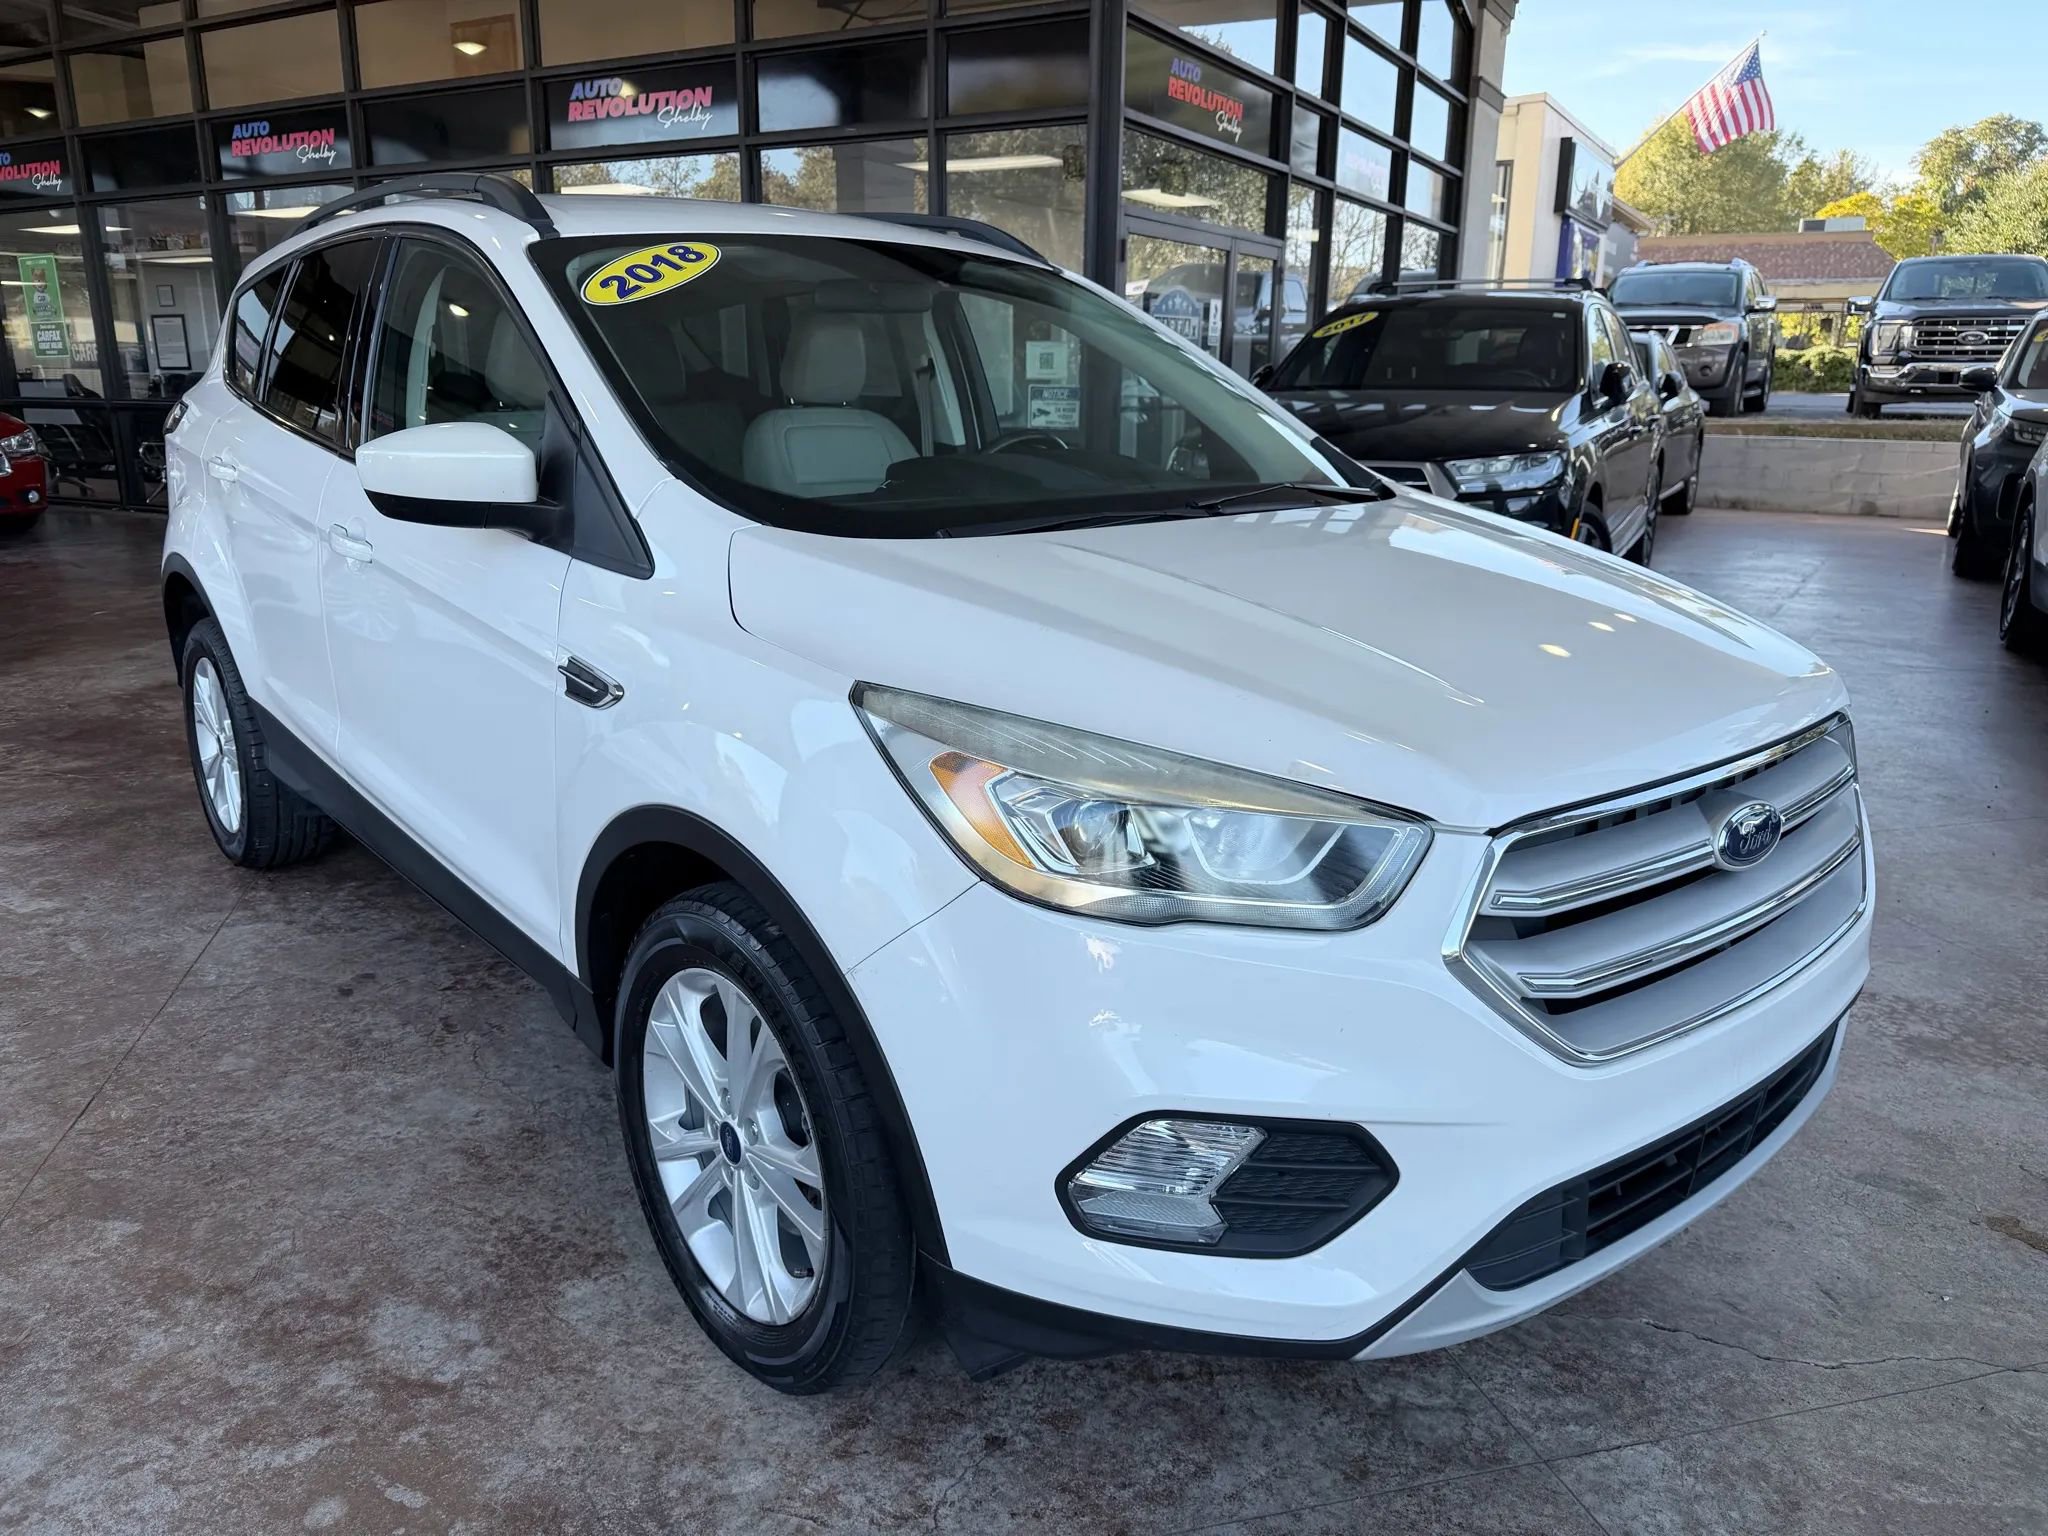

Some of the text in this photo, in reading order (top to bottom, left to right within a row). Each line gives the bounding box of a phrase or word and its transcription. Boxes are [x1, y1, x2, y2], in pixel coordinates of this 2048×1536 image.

[1171, 58, 1200, 82] AUTO
[570, 77, 622, 100] AUTO
[1168, 76, 1243, 121] REVOLUTION
[568, 86, 712, 122] REVOLUTION
[657, 101, 713, 130] Shelby
[232, 121, 269, 139] AUTO
[1216, 111, 1242, 143] Shelby
[231, 128, 335, 157] REVOLUTION
[296, 141, 336, 165] Shelby
[0, 160, 60, 181] VOLUTION
[32, 171, 62, 192] Shelby
[600, 245, 707, 299] 2018
[37, 330, 61, 341] CARFAX
[1740, 818, 1773, 854] Ford
